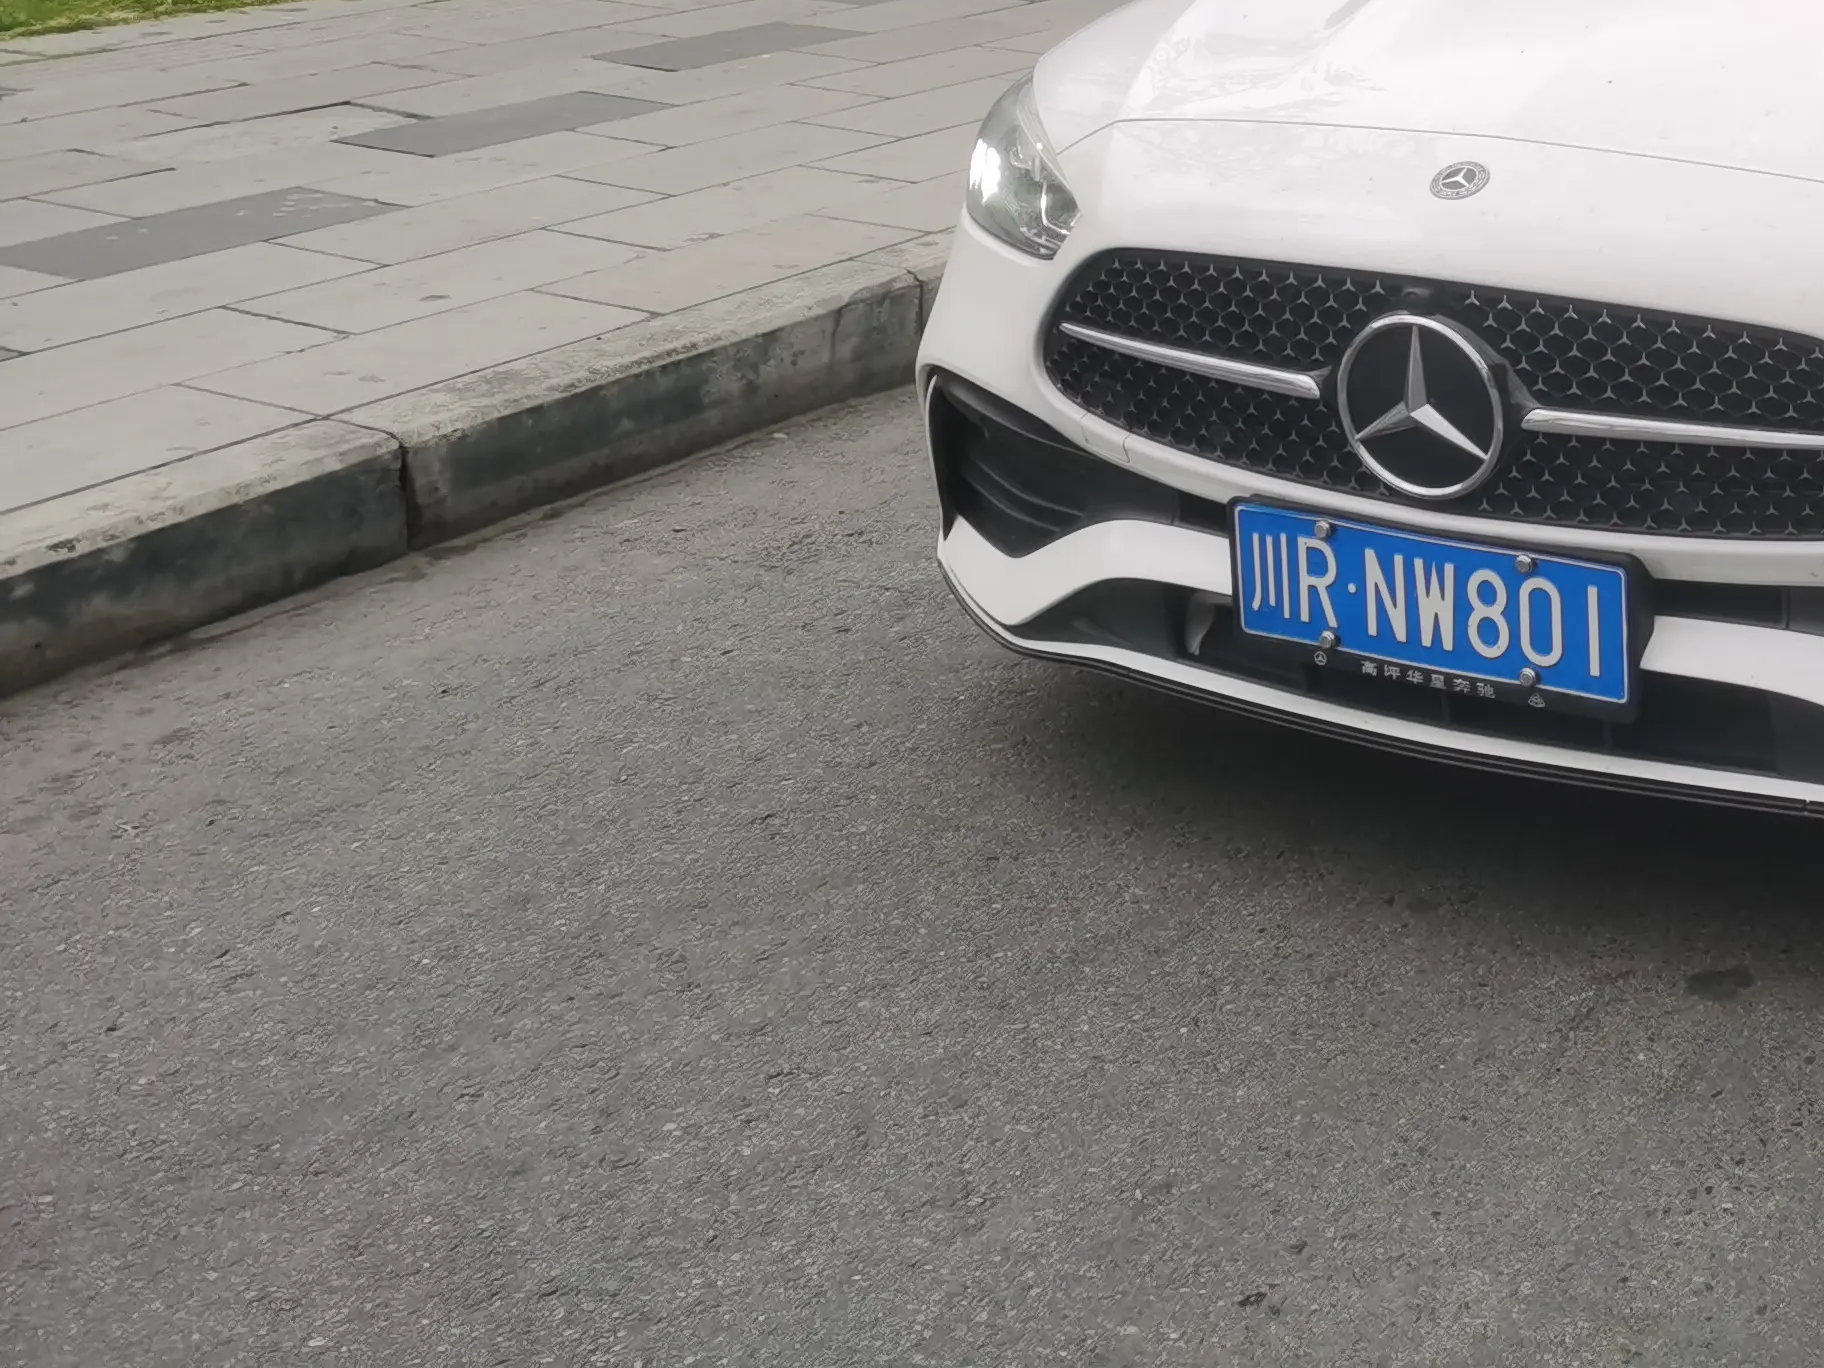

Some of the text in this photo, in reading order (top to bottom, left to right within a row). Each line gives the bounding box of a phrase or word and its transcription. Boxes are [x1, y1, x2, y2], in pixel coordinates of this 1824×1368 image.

[1360, 660, 1496, 699] 高坪华星奔驰
